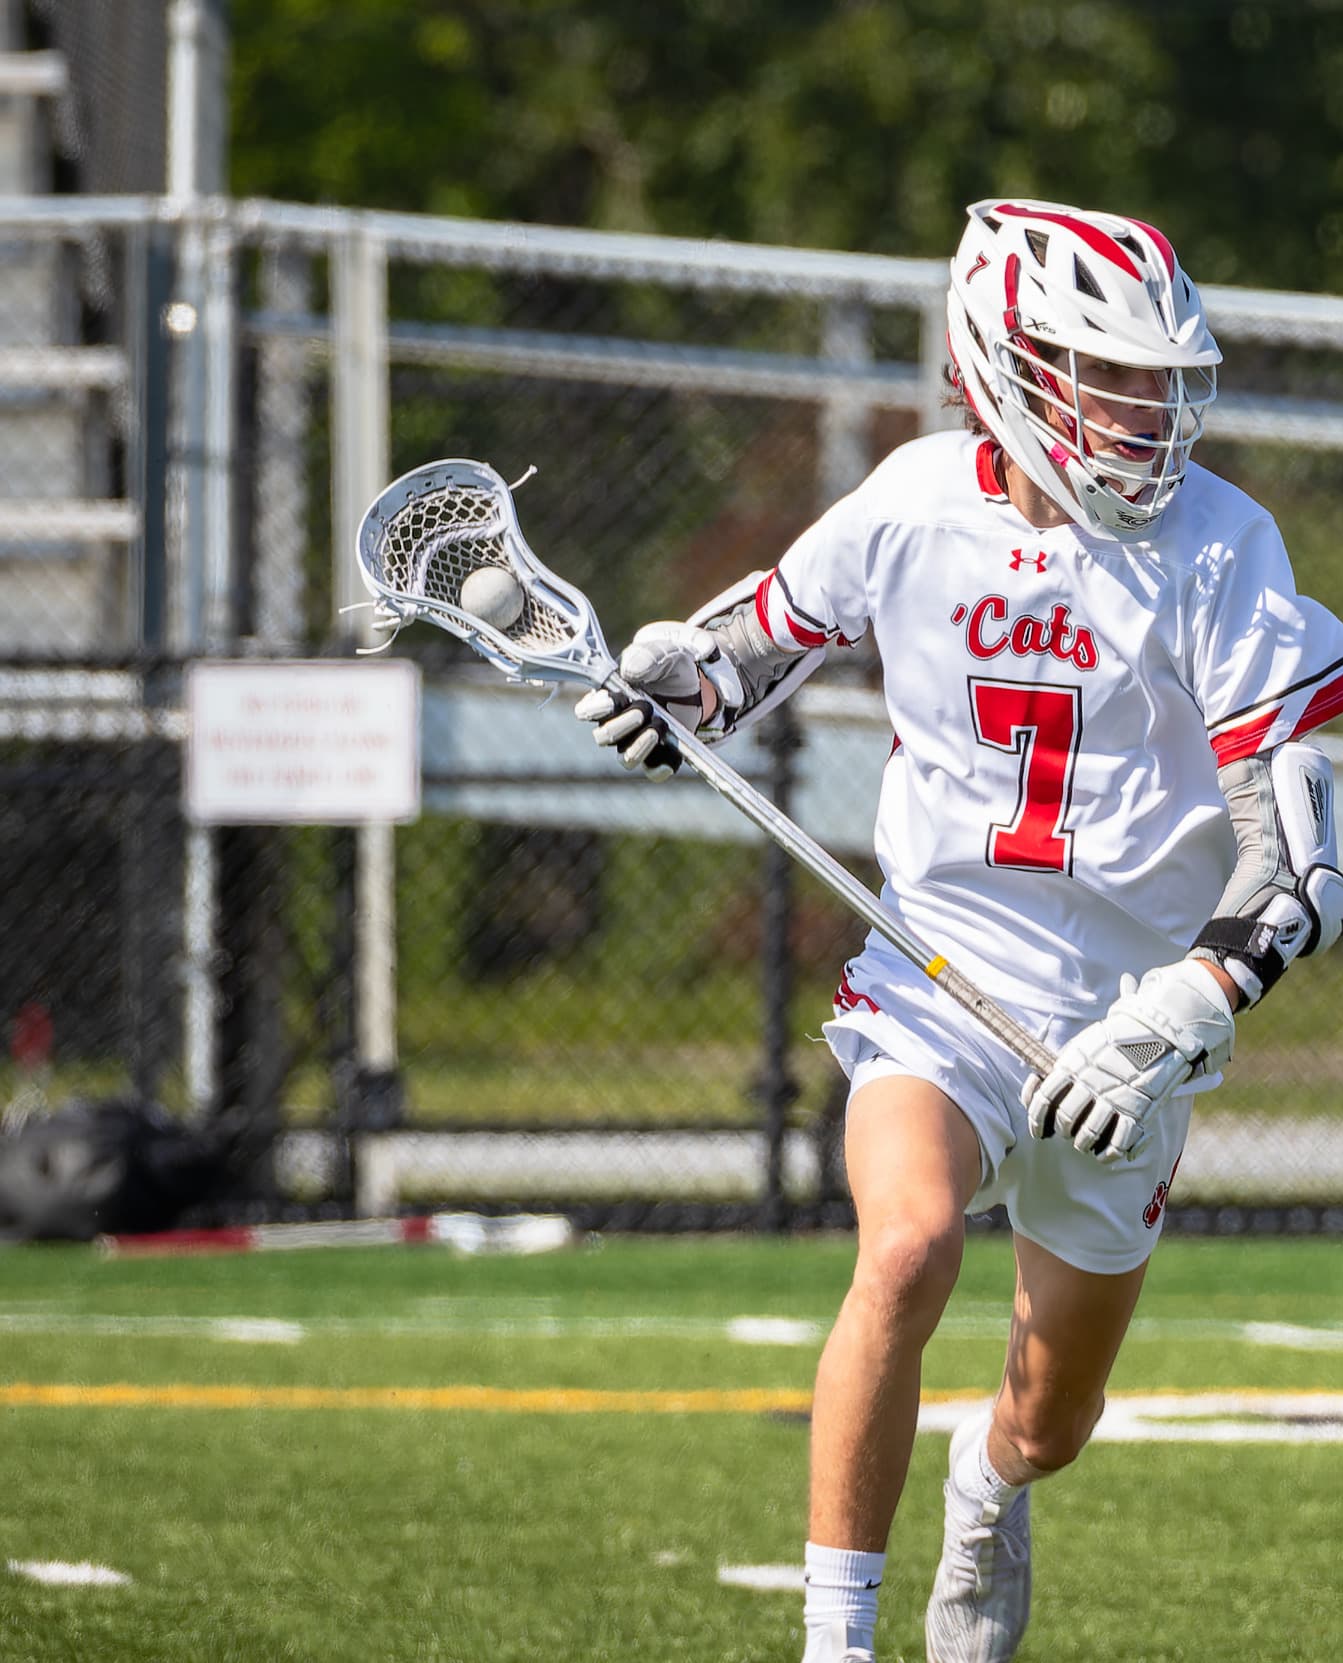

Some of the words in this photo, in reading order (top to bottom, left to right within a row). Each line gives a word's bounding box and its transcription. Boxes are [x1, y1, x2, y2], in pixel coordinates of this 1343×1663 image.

[965, 251, 991, 284] 7
[950, 594, 1098, 671] 'Cats
[967, 675, 1082, 877] 7
